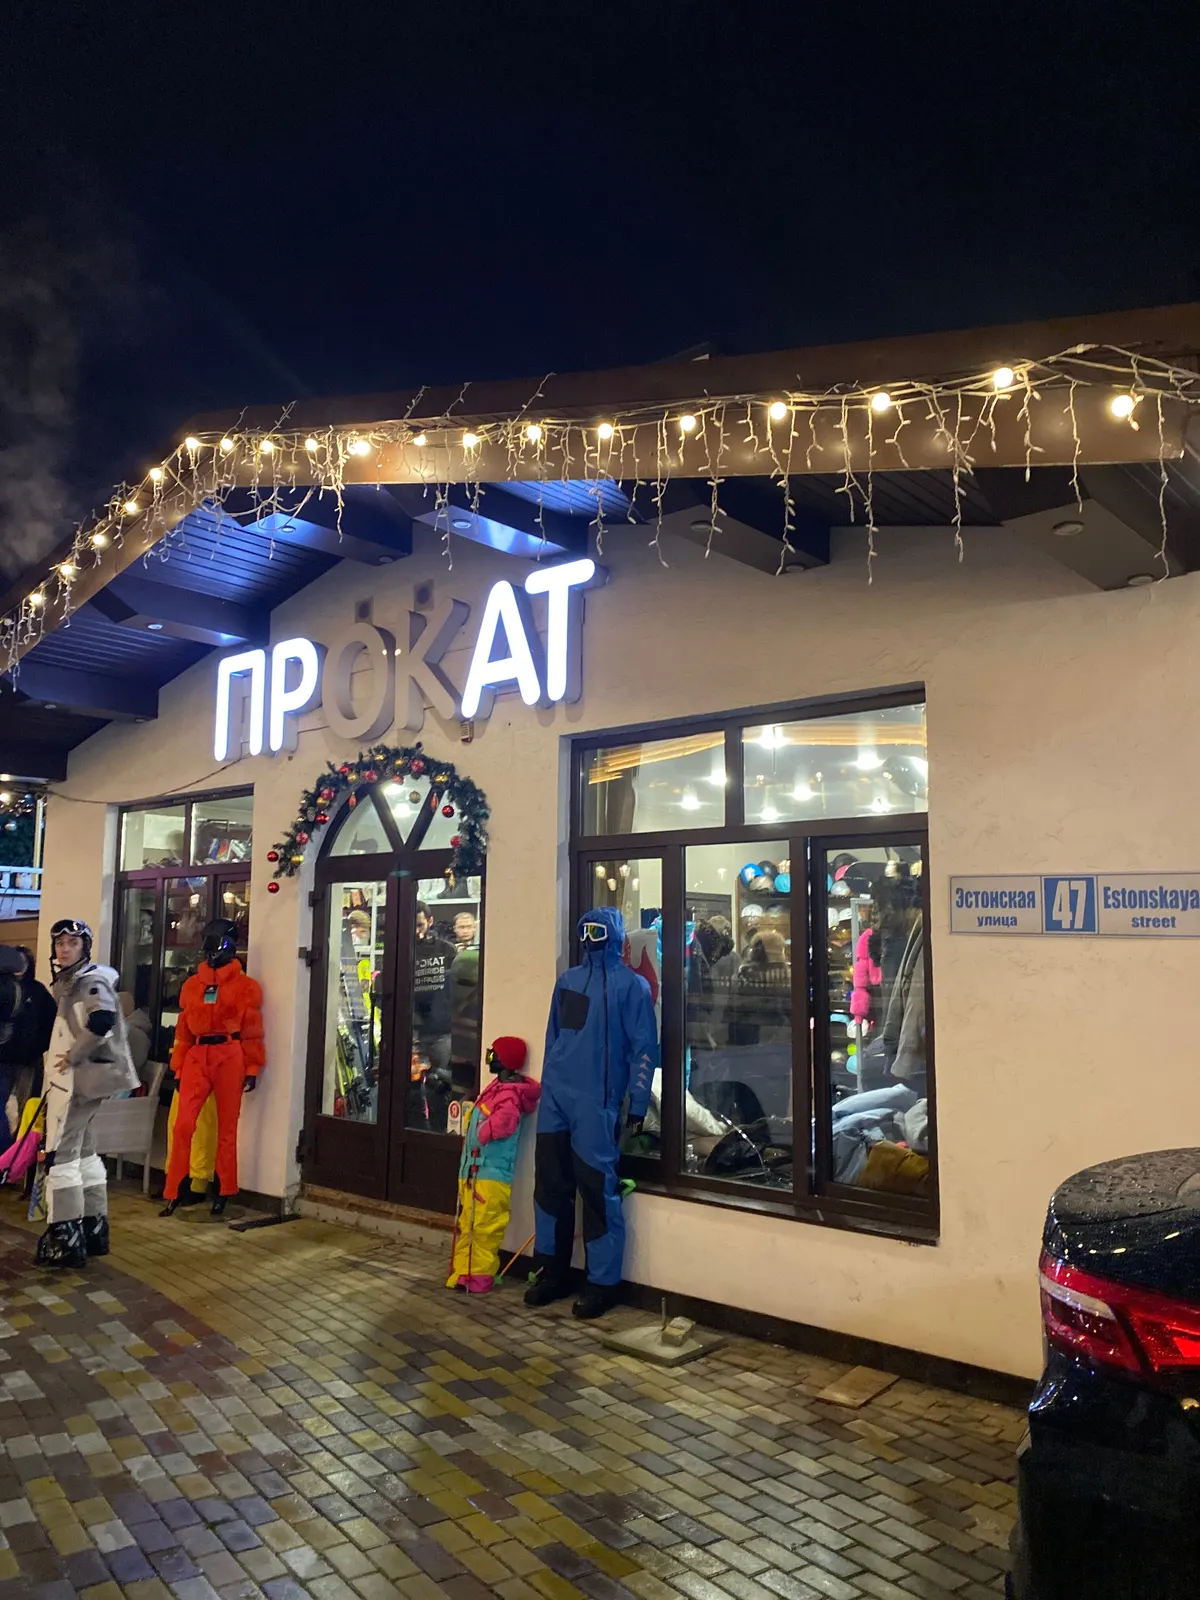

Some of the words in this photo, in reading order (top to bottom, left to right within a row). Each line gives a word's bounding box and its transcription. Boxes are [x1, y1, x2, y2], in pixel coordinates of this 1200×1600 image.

[214, 558, 595, 761] ПРОКАТ
[955, 887, 1036, 909] Эстонская
[1052, 880, 1087, 929] 47
[1103, 885, 1200, 912] Estonskaya
[977, 915, 1018, 927] улица
[1131, 916, 1177, 928] street
